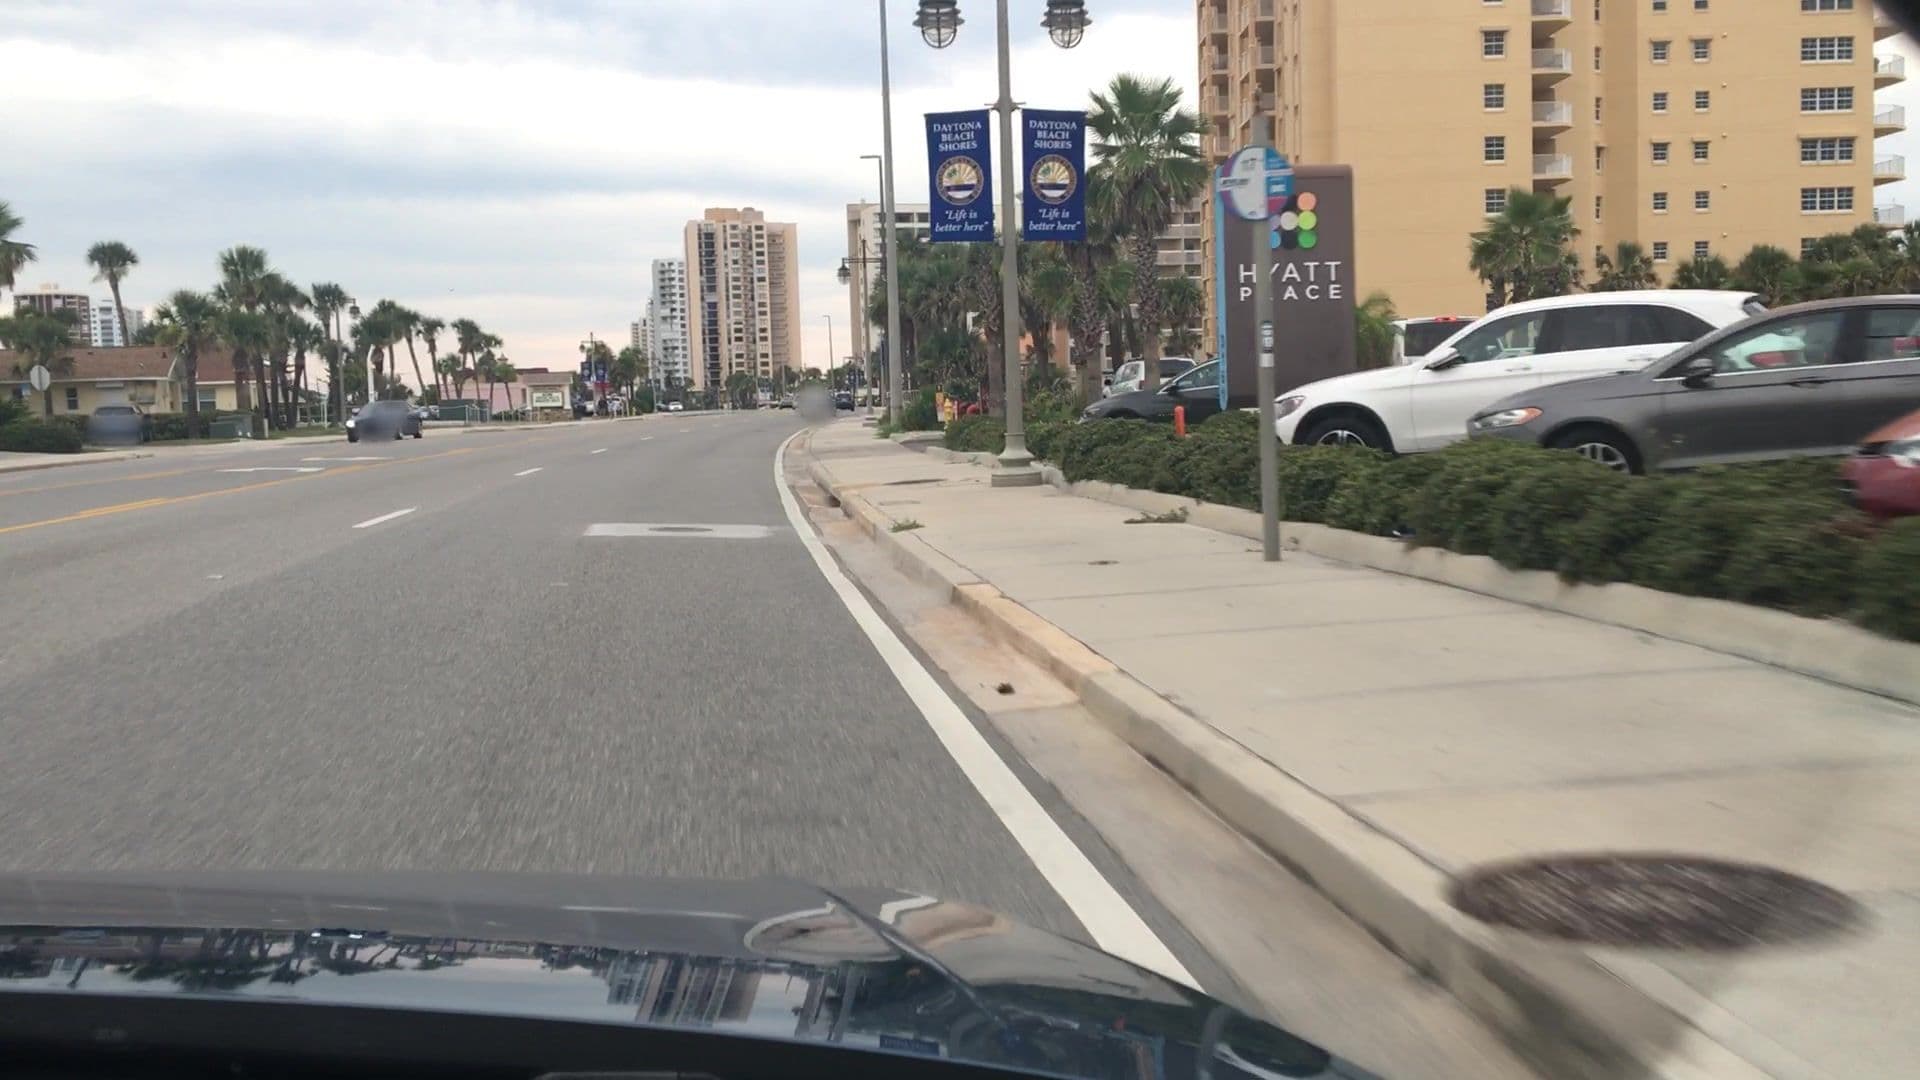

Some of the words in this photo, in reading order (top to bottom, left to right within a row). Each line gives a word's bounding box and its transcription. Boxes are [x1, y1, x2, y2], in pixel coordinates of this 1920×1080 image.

[933, 121, 982, 132] DAYTONA
[1029, 119, 1078, 130] DAYTONA
[941, 131, 975, 142] BEACH
[1037, 130, 1070, 140] BEACH
[938, 140, 978, 152] SHORES
[1033, 139, 1073, 150] SHORES
[945, 209, 968, 222] "Life
[968, 209, 978, 219] is
[1038, 208, 1060, 220] "Life
[1061, 208, 1070, 218] is
[935, 222, 962, 232] better
[962, 221, 989, 232] here"
[1029, 220, 1056, 231] better
[1056, 220, 1081, 231] here"
[1239, 284, 1343, 302] PACE
